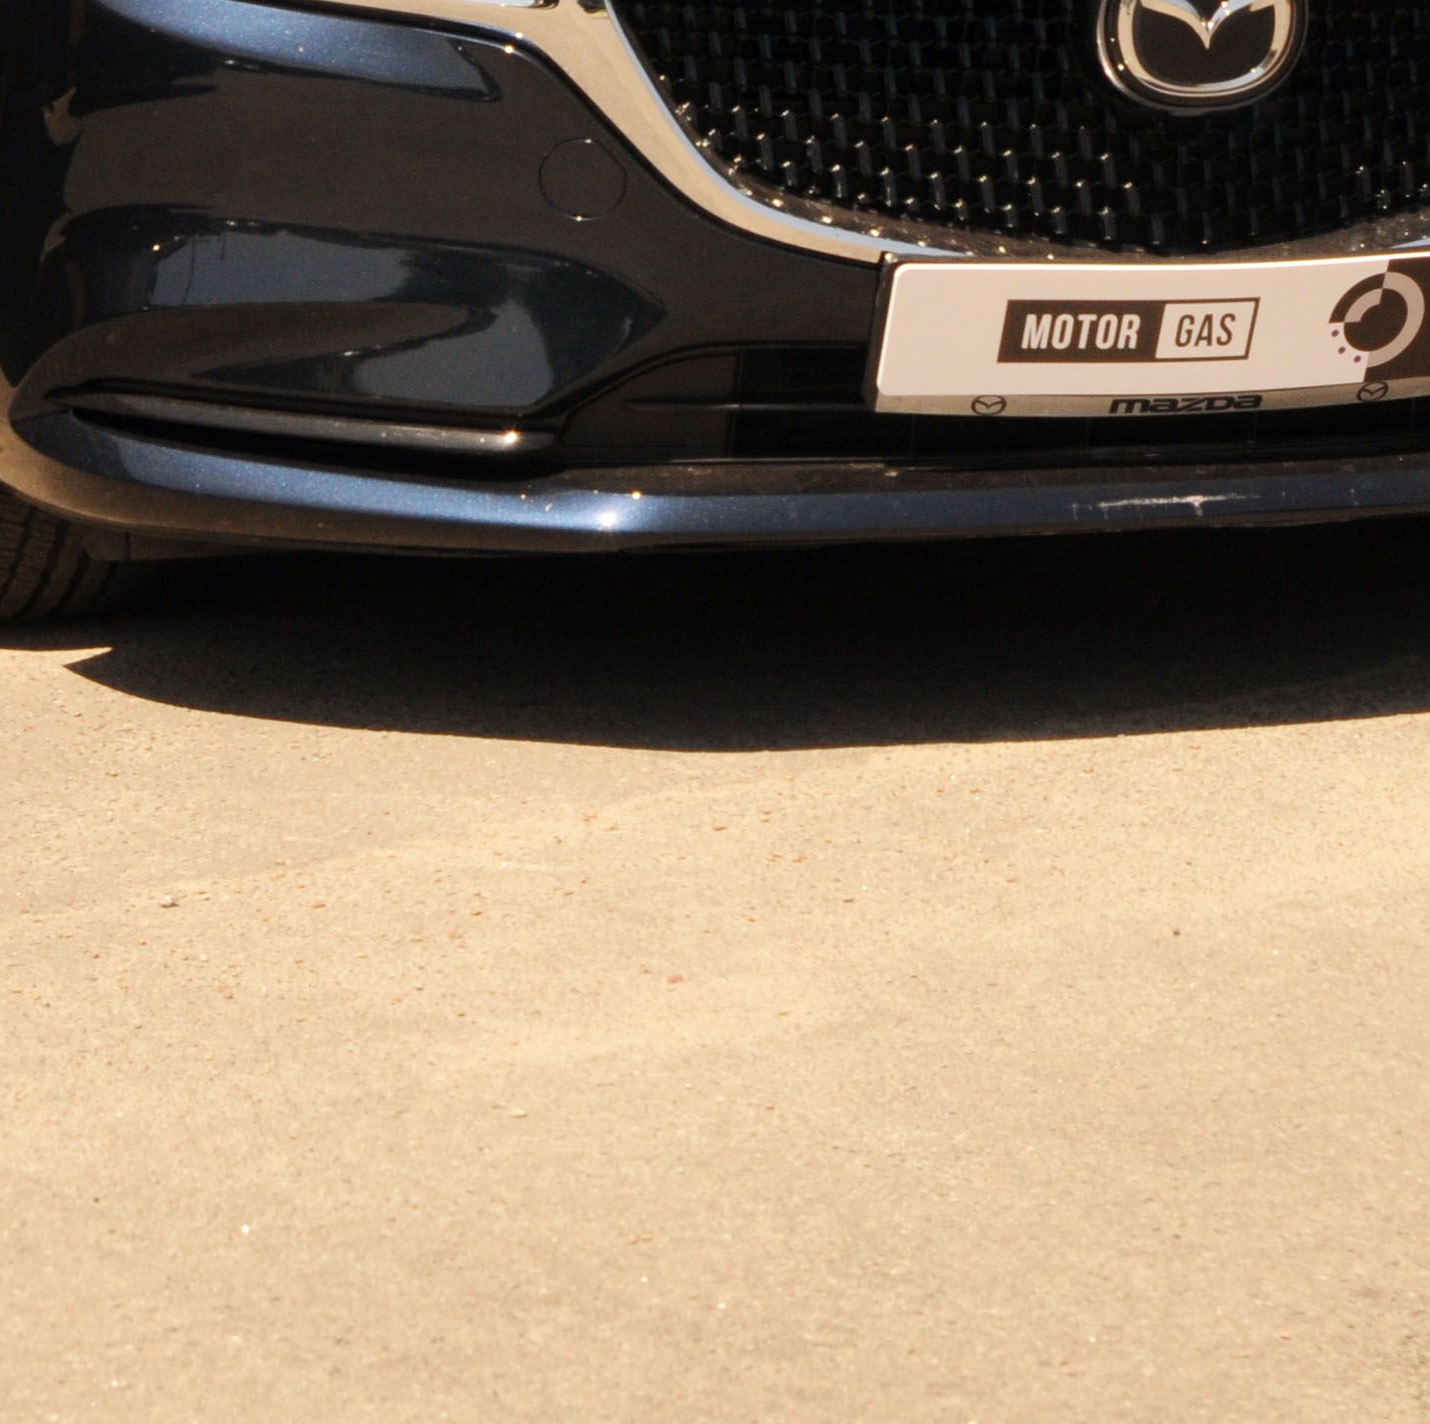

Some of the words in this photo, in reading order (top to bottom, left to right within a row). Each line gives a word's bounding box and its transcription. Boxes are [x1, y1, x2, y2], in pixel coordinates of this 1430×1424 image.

[1021, 313, 1141, 351] MOTOR
[1174, 312, 1237, 348] GAS
[1109, 394, 1263, 414] mazda
